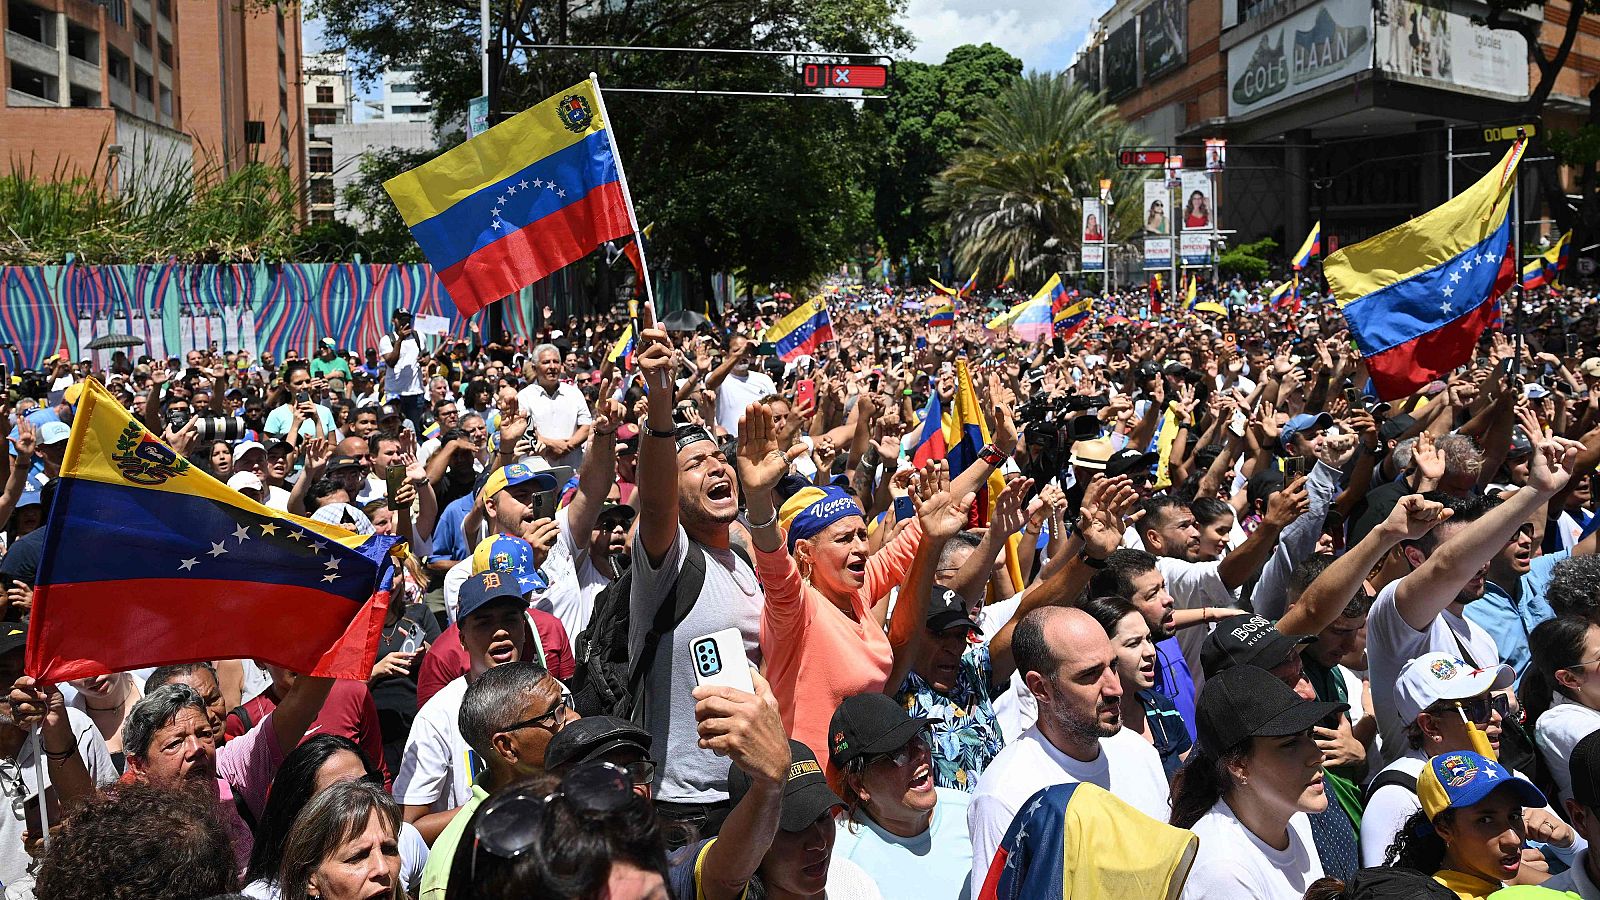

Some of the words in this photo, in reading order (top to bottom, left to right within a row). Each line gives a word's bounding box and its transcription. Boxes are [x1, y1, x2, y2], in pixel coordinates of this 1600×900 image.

[1243, 56, 1287, 98] COLE
[1294, 29, 1349, 74] HAAN
[805, 64, 830, 87] 01
[1484, 128, 1502, 143] 00
[481, 572, 502, 593] D
[1230, 613, 1271, 642] BOSS
[1247, 631, 1266, 647] HUGO
